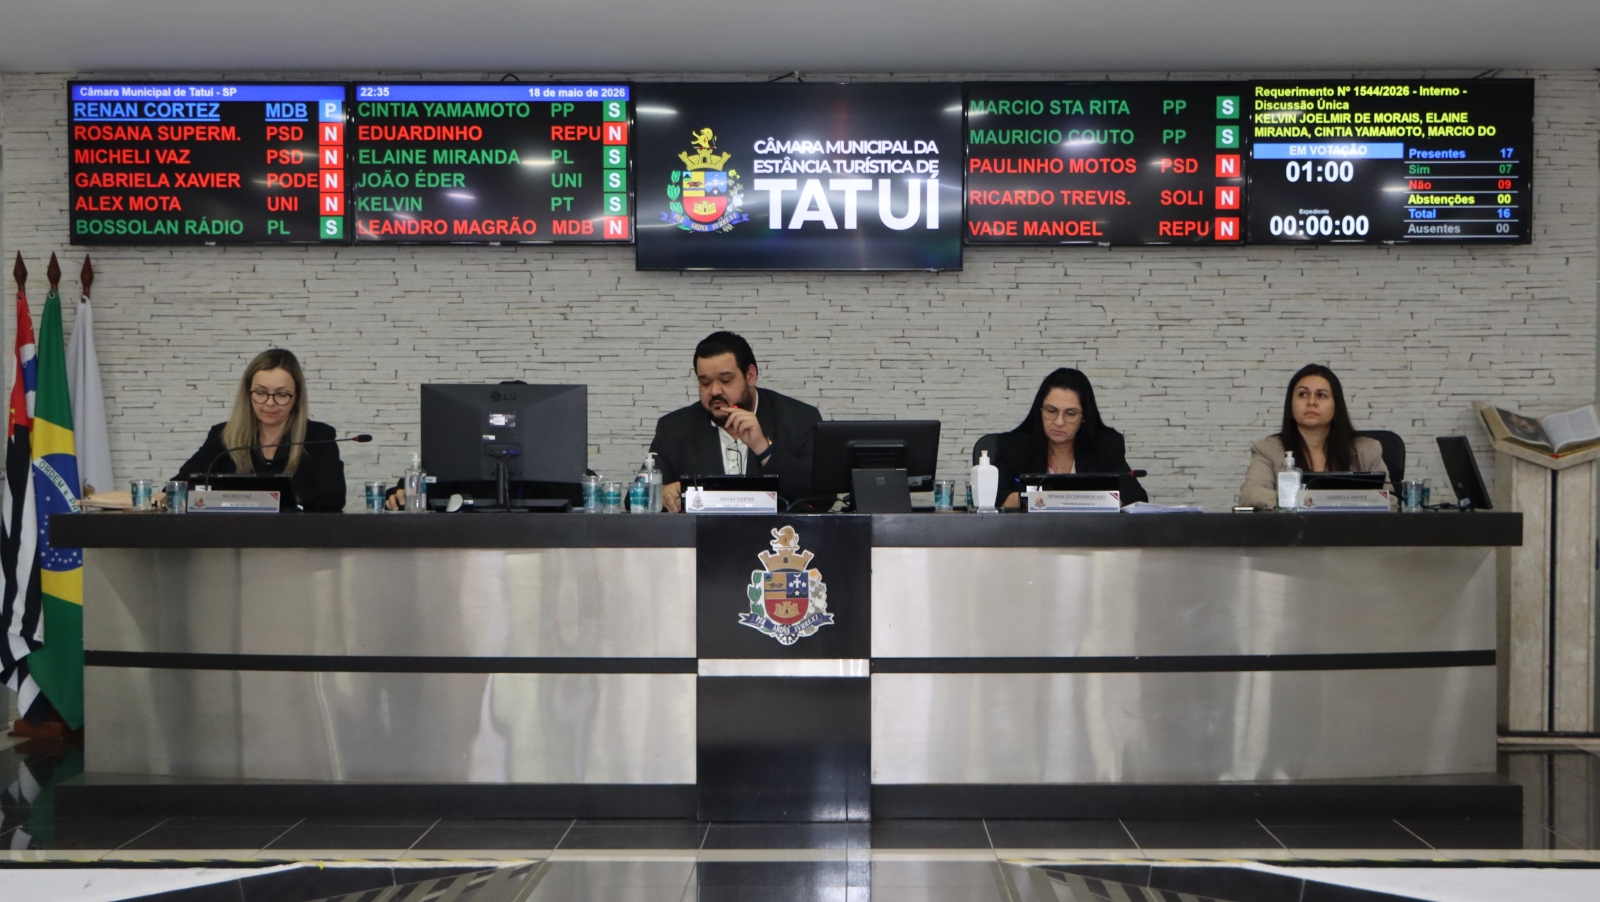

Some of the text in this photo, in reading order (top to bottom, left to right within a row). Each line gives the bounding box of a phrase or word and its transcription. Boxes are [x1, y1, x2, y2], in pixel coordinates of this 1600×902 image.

[80, 87, 120, 97] Câmara
[122, 87, 171, 99] Municipal
[173, 87, 186, 97] de
[222, 87, 237, 97] SP
[360, 87, 626, 98] 22:35 18 de maio de 2026
[1255, 86, 1334, 99] Requerimento
[1354, 86, 1410, 97] 1544/2026
[1419, 86, 1460, 96] Interno
[74, 103, 337, 118] RENAN CORTEZ MDB P
[357, 102, 621, 118] CINTIA YAMAMOTO PP S
[970, 100, 1234, 115] MARCIO STA RITA PP S
[1255, 98, 1350, 111] Discussão Única
[1255, 112, 1468, 126] KELVIN JOELMIR DE MORAIS, ELAINE
[74, 126, 337, 141] ROSANA SUPERM. PSD N
[358, 125, 622, 141] EDUARDINHO REPU N
[970, 129, 1234, 145] MAURICIO COUTO PP S
[1254, 126, 1496, 139] MIRANDA, CINTIA YAMAMOTO, MARCIO DO
[754, 137, 939, 154] CÂMARA MUNICIPAL DA
[1289, 143, 1368, 158] EM VOTAÇÃO
[75, 149, 338, 165] MICHELI VAZ PSD N
[359, 149, 621, 165] ELAINE MIRANDA PL S
[1409, 148, 1514, 159] Presentes 17
[753, 156, 939, 174] ESTÂNCIA TURÍSTICA DE
[969, 158, 1234, 174] PAULINHO MOTOS PSD N
[1285, 161, 1354, 182] 01:00
[1409, 164, 1513, 175] Sim 07
[75, 173, 338, 188] GABRIELA XAVIER PODE N
[357, 169, 621, 188] JOÃO ÉDER UNI S
[1409, 179, 1512, 190] Não 09
[75, 196, 338, 212] ALEX MOTA UNI N
[358, 196, 621, 212] KELVIN PT S
[753, 173, 940, 230] TATUÍ
[969, 190, 1234, 205] RICARDO TREVIS. SOLI N
[1408, 194, 1511, 207] Abstenções 00
[1408, 209, 1511, 219] Total 16
[76, 216, 338, 235] BOSSOLAN RÁDIO PL S
[358, 217, 622, 235] LEANDRO MAGRÃO MDB N
[969, 221, 1233, 236] VADE MANOEL REPU N
[1270, 215, 1369, 236] 00:00:00
[1408, 223, 1510, 234] Ausentes 00
[504, 392, 516, 400] LG
[38, 460, 65, 489] ORDEM
